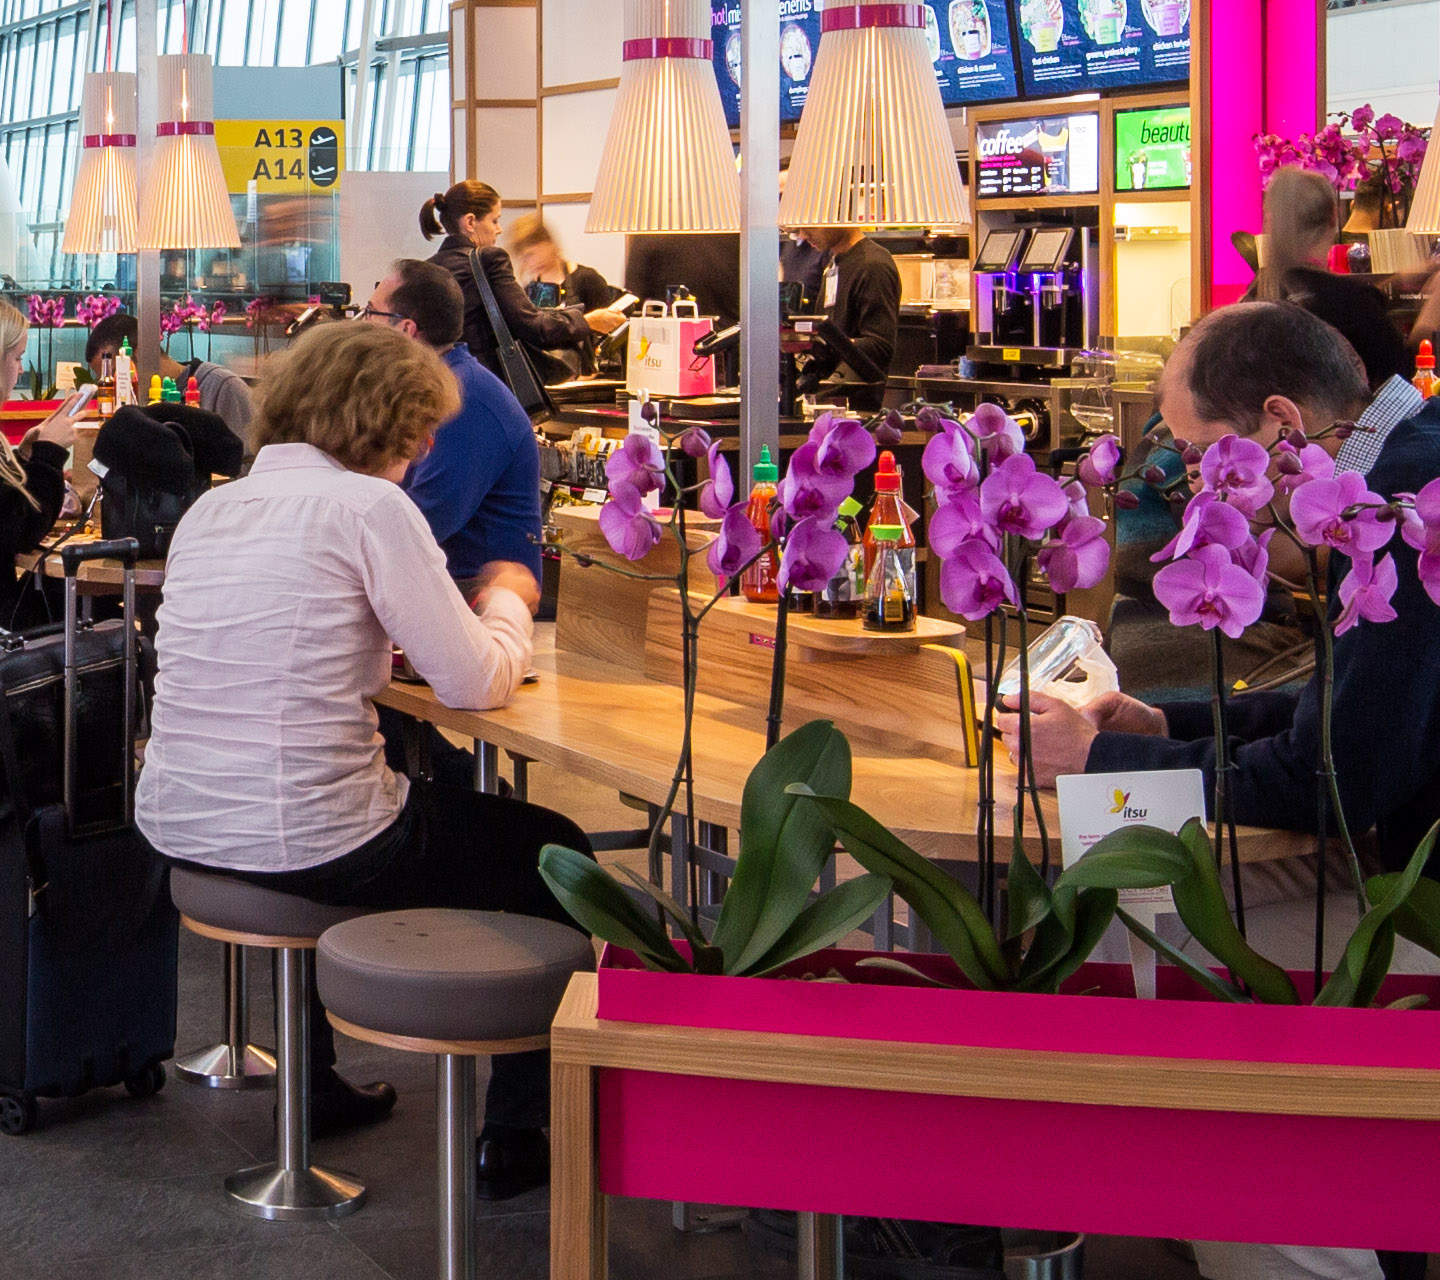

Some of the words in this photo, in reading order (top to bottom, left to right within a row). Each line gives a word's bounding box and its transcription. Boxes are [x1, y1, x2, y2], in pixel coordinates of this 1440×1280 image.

[254, 128, 303, 149] A13
[979, 128, 1024, 158] coffee
[252, 158, 305, 181] A14
[644, 354, 662, 368] itsu
[1123, 806, 1148, 819] itsu
